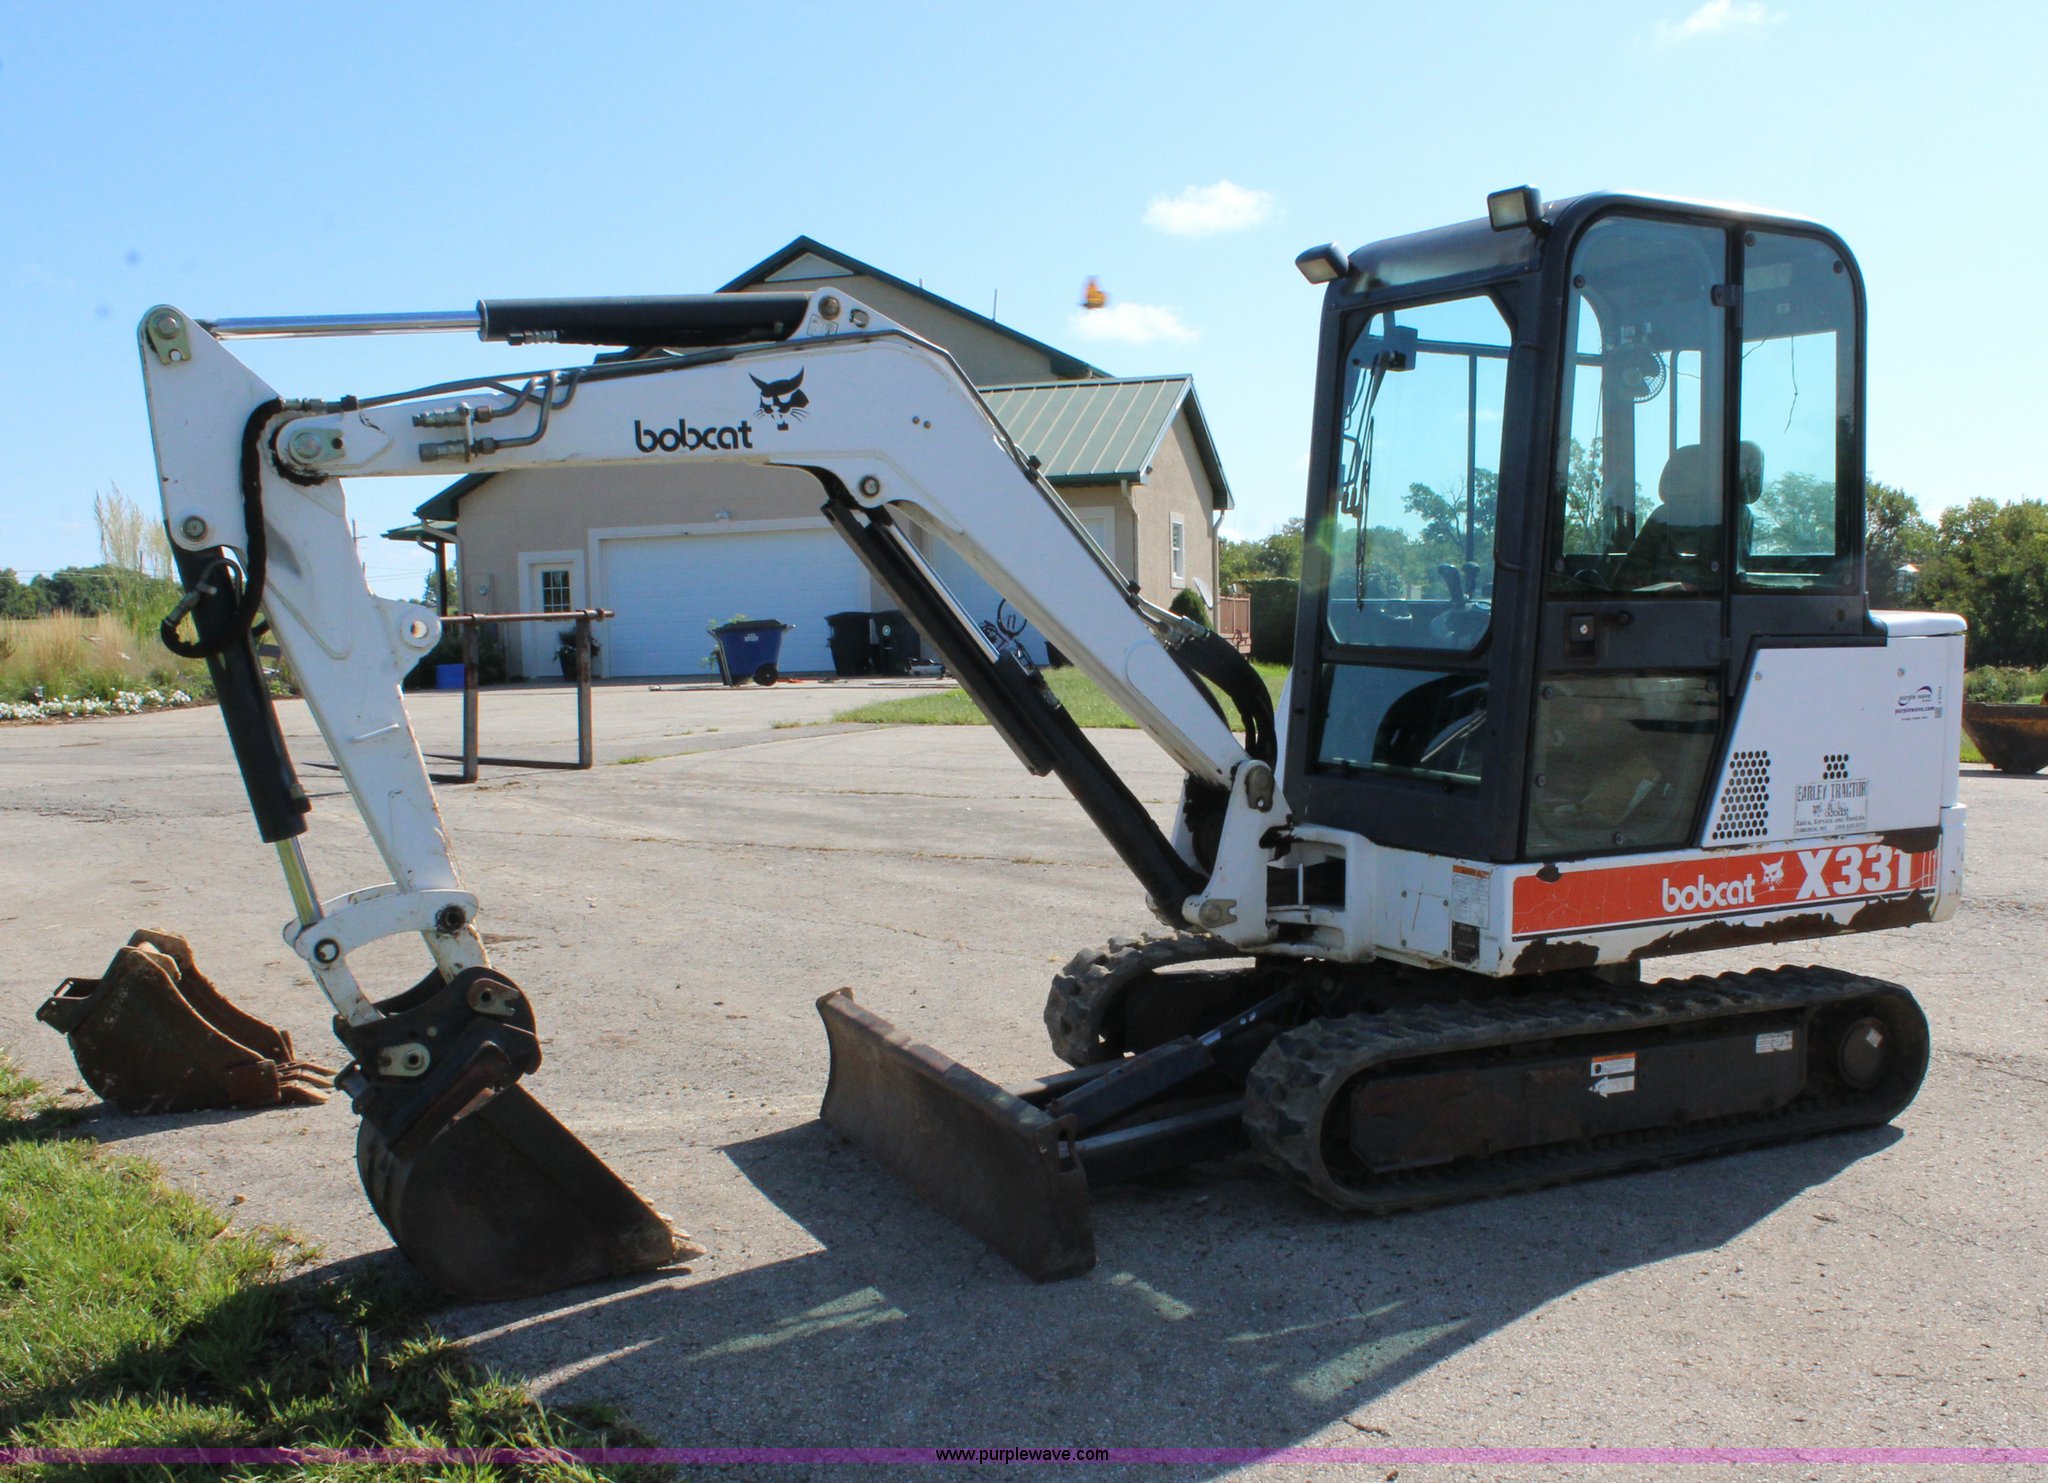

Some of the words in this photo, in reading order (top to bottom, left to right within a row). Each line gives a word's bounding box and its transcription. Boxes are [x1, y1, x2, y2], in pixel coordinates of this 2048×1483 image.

[634, 418, 753, 453] bobcat
[1797, 784, 1827, 801] EARLEY
[1831, 782, 1866, 800] TRACTOR
[1662, 873, 1755, 912] bobcat
[1795, 844, 1912, 900] X331
